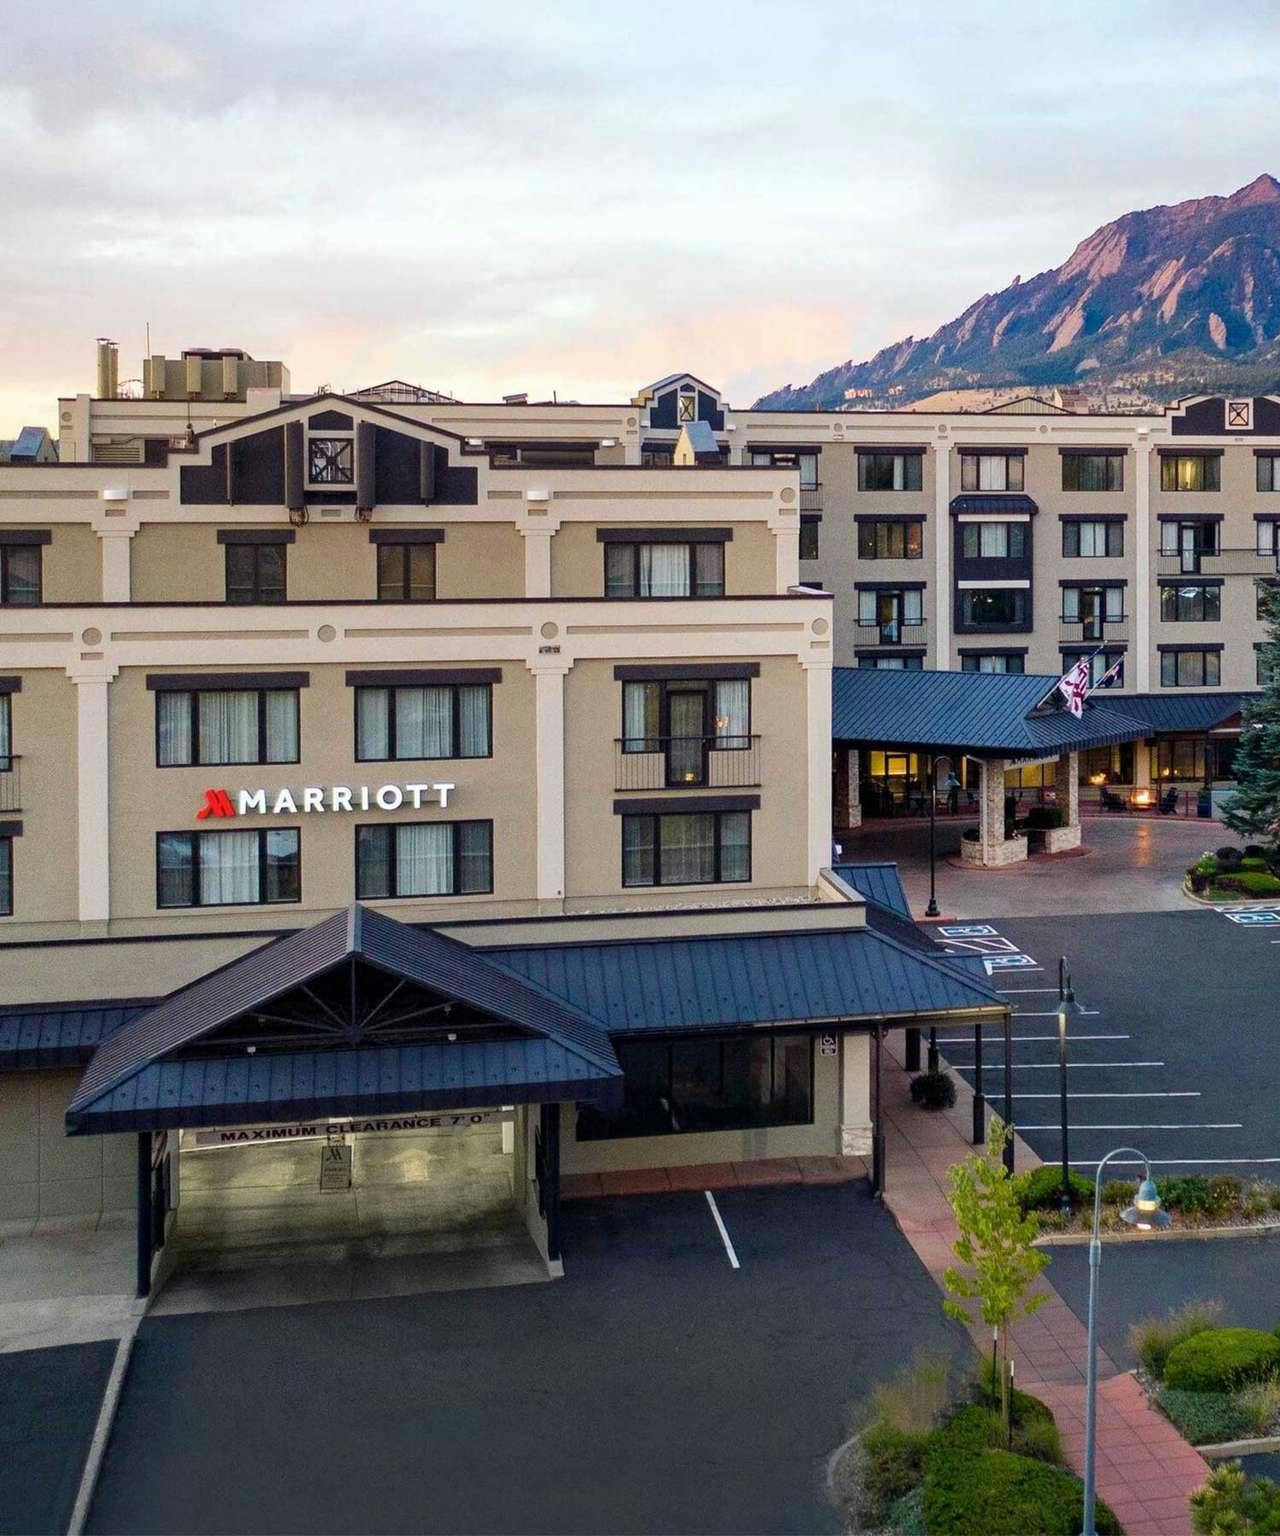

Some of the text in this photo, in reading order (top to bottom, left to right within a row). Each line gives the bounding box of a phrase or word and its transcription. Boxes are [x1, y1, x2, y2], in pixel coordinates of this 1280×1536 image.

[239, 783, 456, 815] MARRIOTT
[220, 1126, 317, 1141] MAXIMUM
[325, 1117, 442, 1134] CLEARANCE
